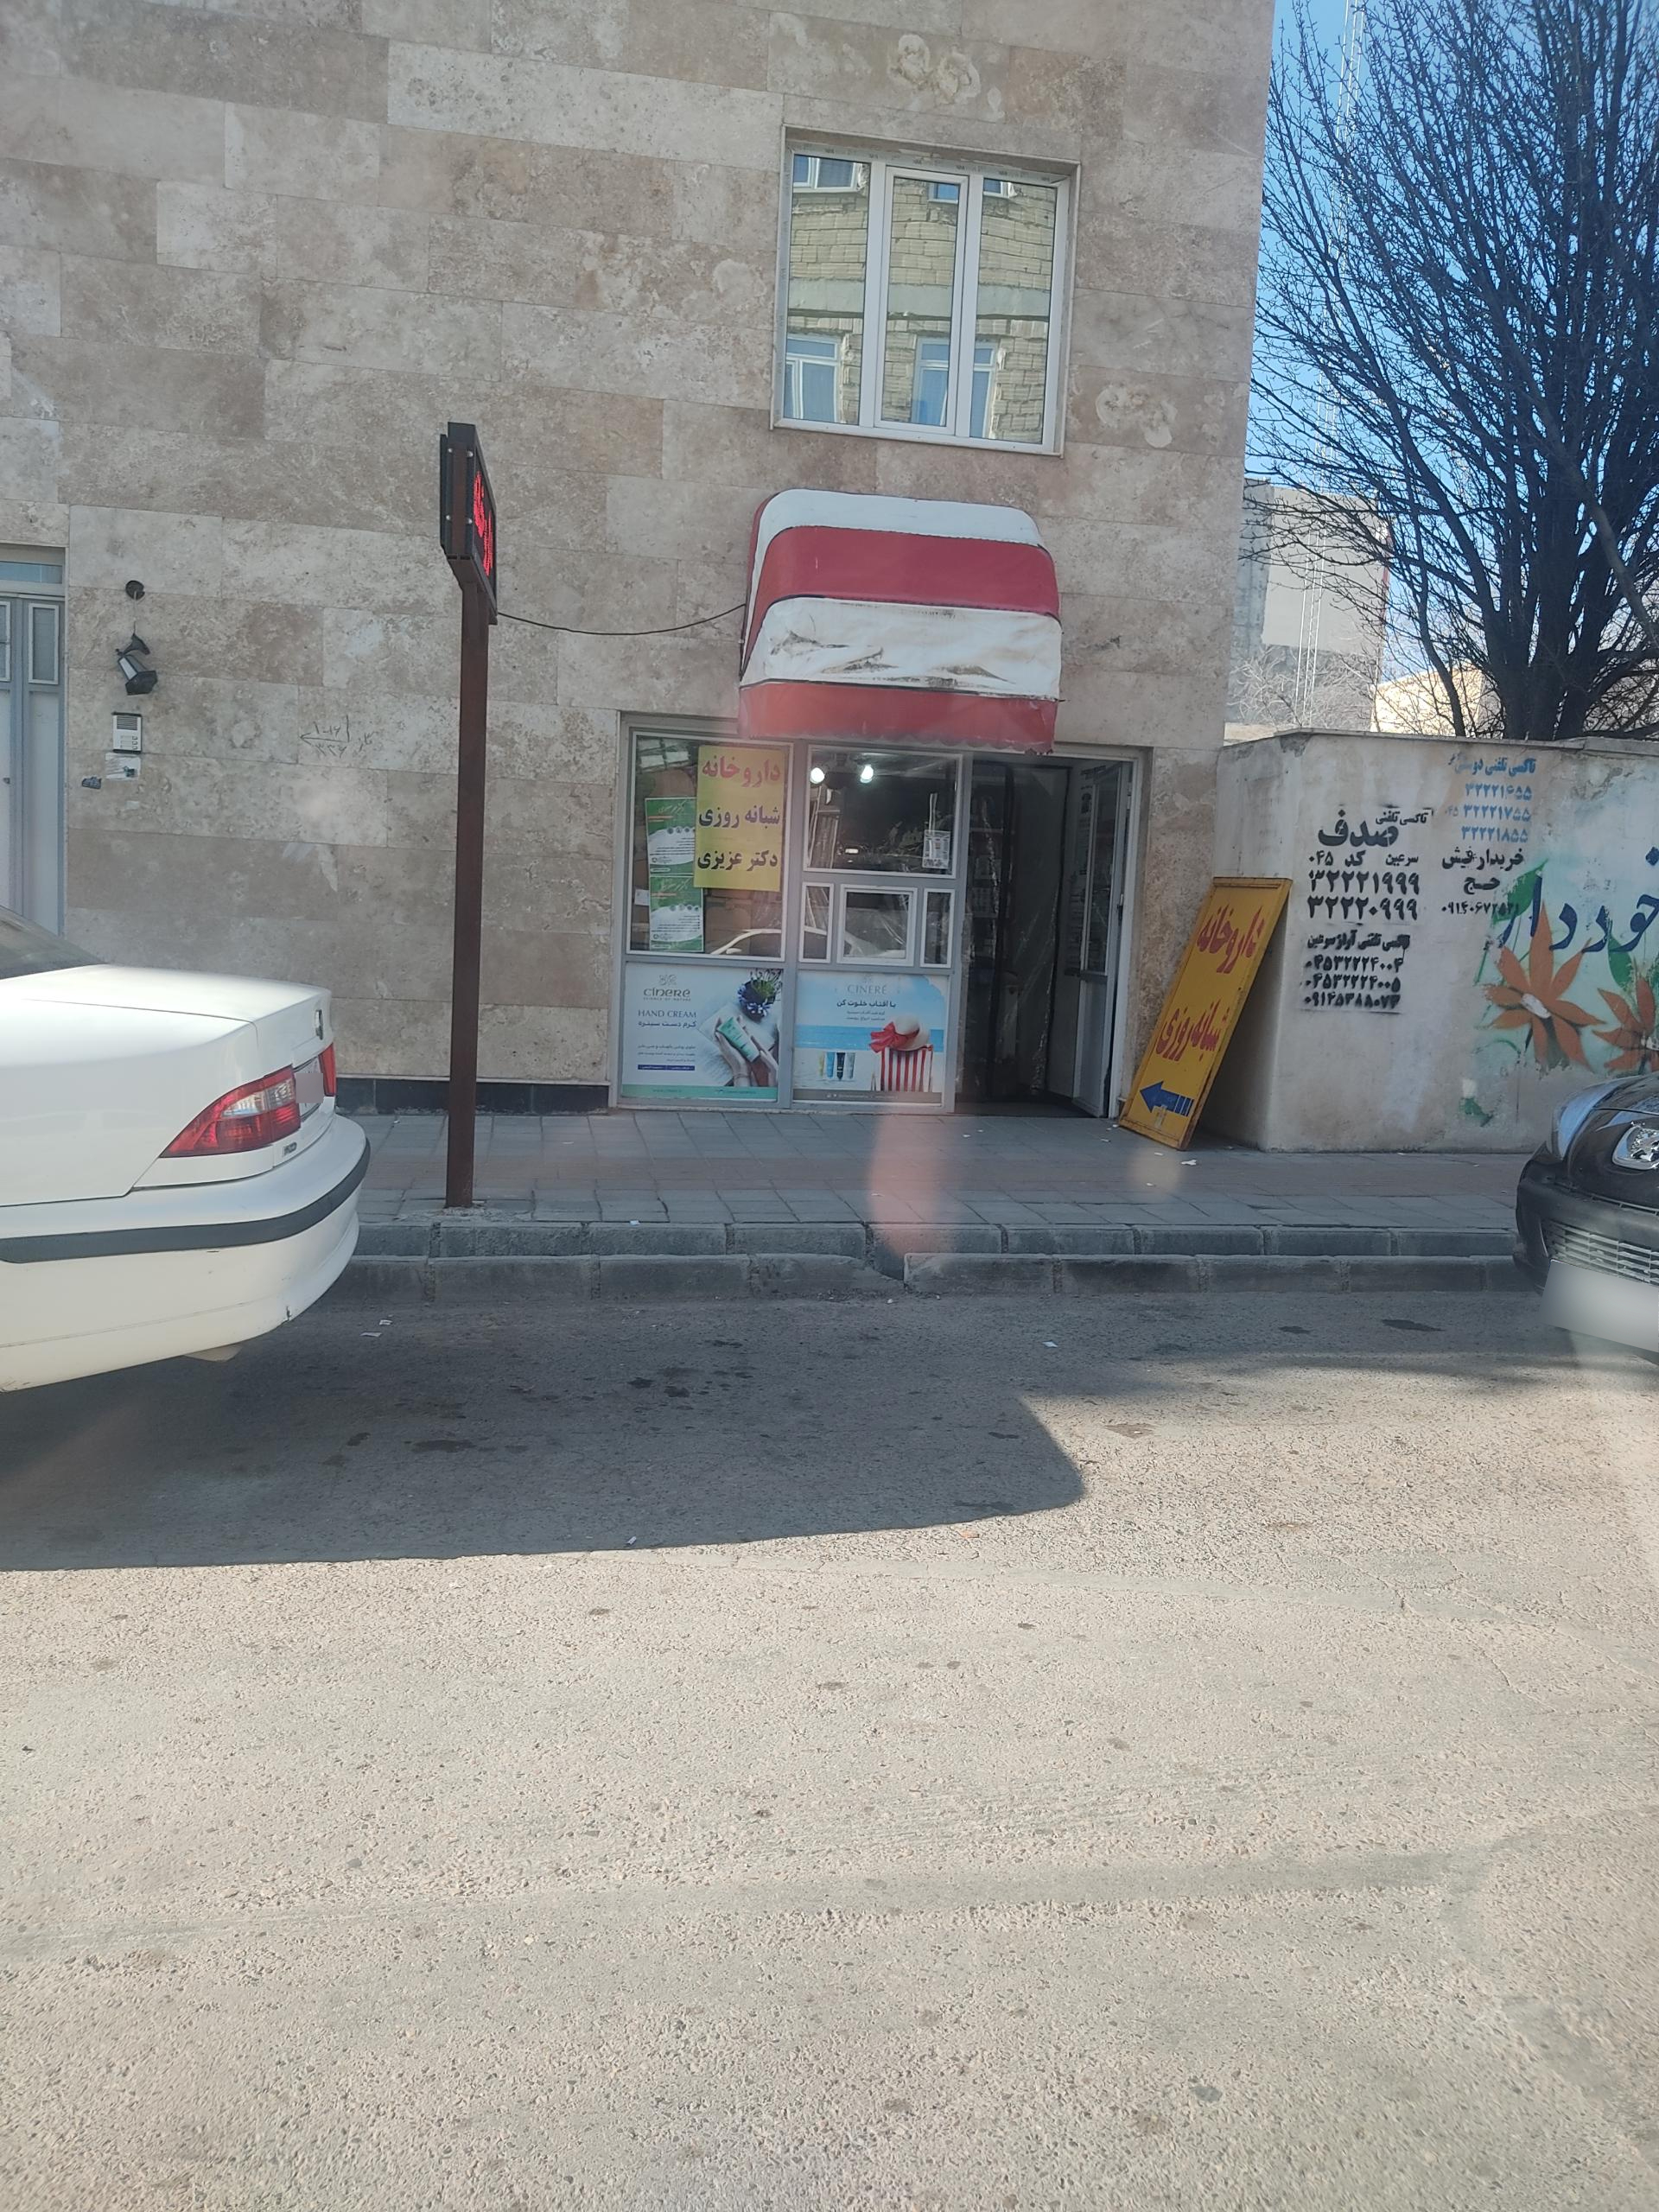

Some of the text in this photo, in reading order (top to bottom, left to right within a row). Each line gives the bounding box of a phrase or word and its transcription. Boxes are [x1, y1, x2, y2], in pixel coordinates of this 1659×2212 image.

[702, 754, 781, 788] داروخانه
[698, 806, 741, 829] روزی
[744, 805, 781, 830] شبانه
[1318, 809, 1399, 848] صدف
[1375, 810, 1431, 826] تاکسی تلفنی
[1460, 825, 1529, 843] ۳۲۲۲۱۸۵۵
[697, 849, 779, 872] دکتر عزیزی
[1308, 849, 1420, 868] سرعین کد ۰۴۵
[1441, 845, 1525, 872] خریدار فیش
[1308, 868, 1420, 895] ۳۲۲۲۱۹۹۹
[1463, 875, 1501, 895] حج
[1306, 895, 1418, 921] ۳۲۲۲۰۹۹۹
[1196, 904, 1266, 975] داروخانه
[667, 1009, 697, 1018] CREAM
[1154, 998, 1230, 1063] شبانه روزی
